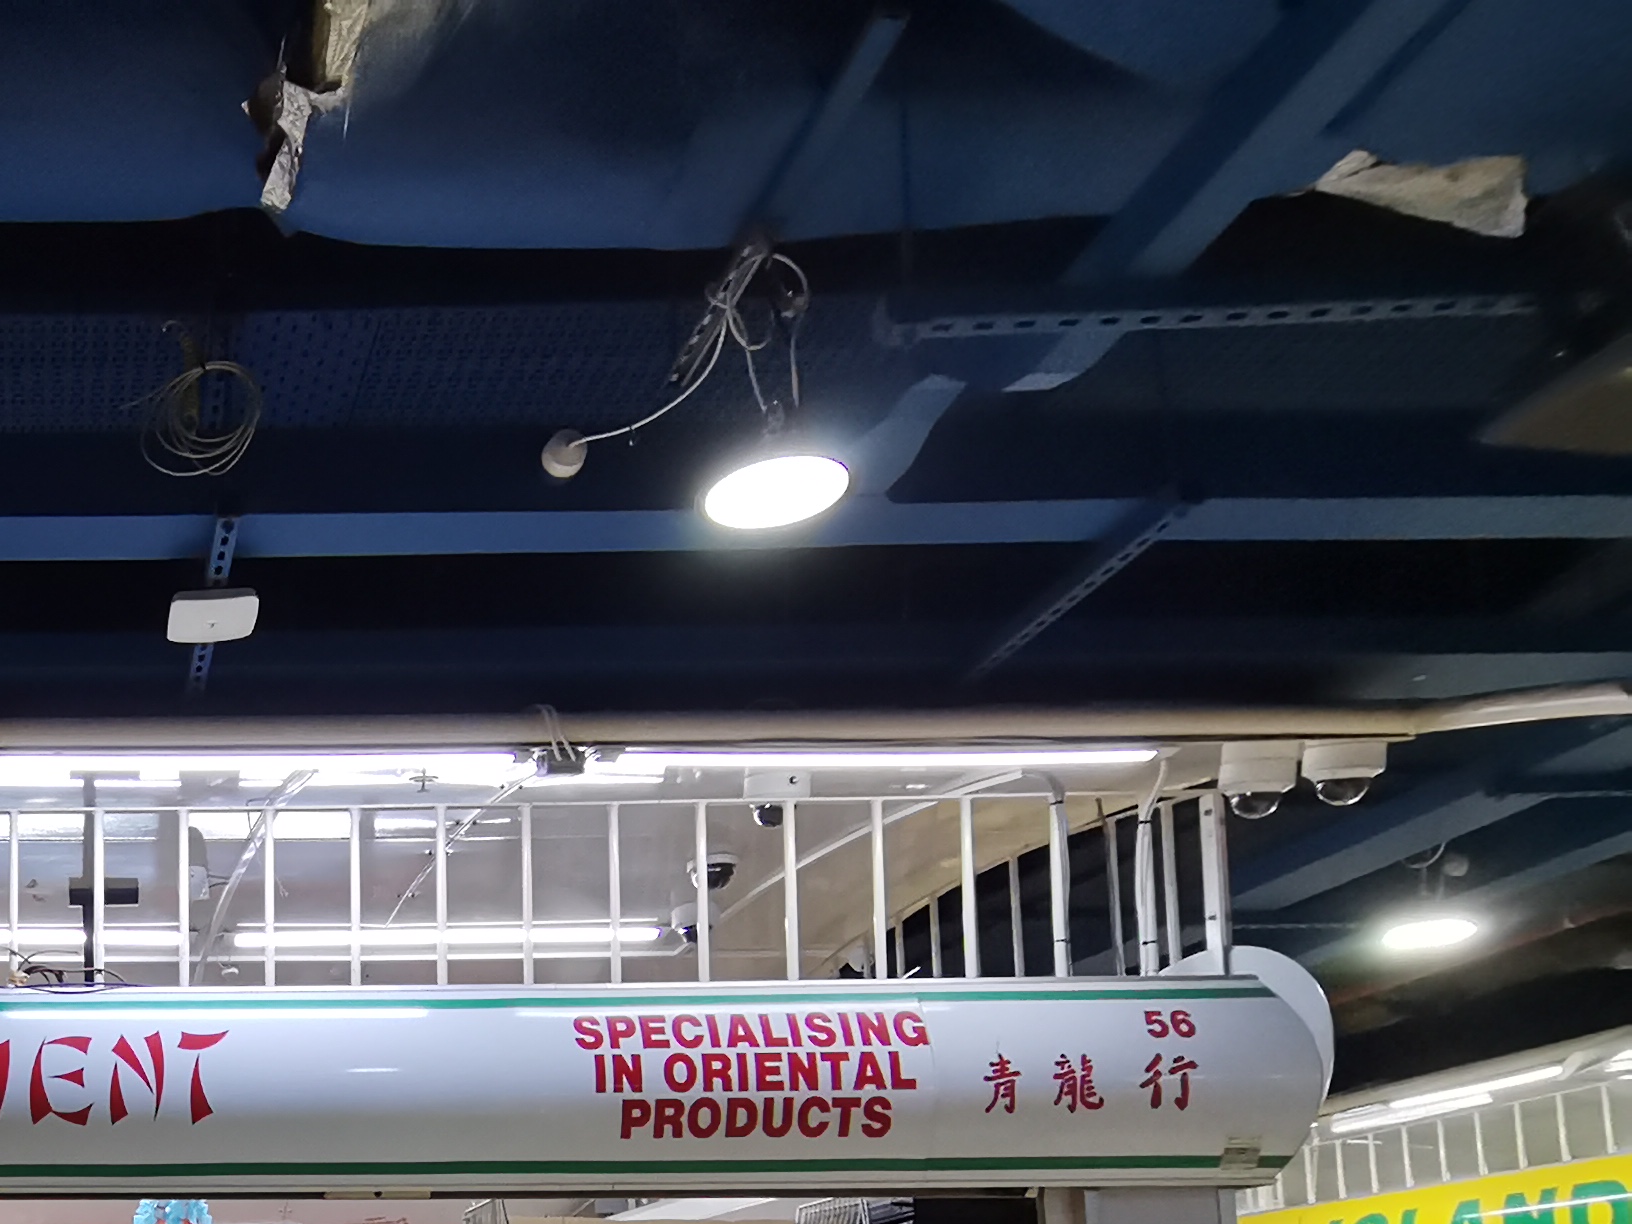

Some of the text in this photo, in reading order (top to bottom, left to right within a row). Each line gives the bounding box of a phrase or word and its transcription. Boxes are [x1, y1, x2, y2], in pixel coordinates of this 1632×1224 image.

[573, 1009, 930, 1051] SPECIALISING
[1145, 1009, 1197, 1038] 56
[594, 1050, 917, 1094] IN ORIENTAL
[620, 1096, 893, 1140] PRODUCTS
